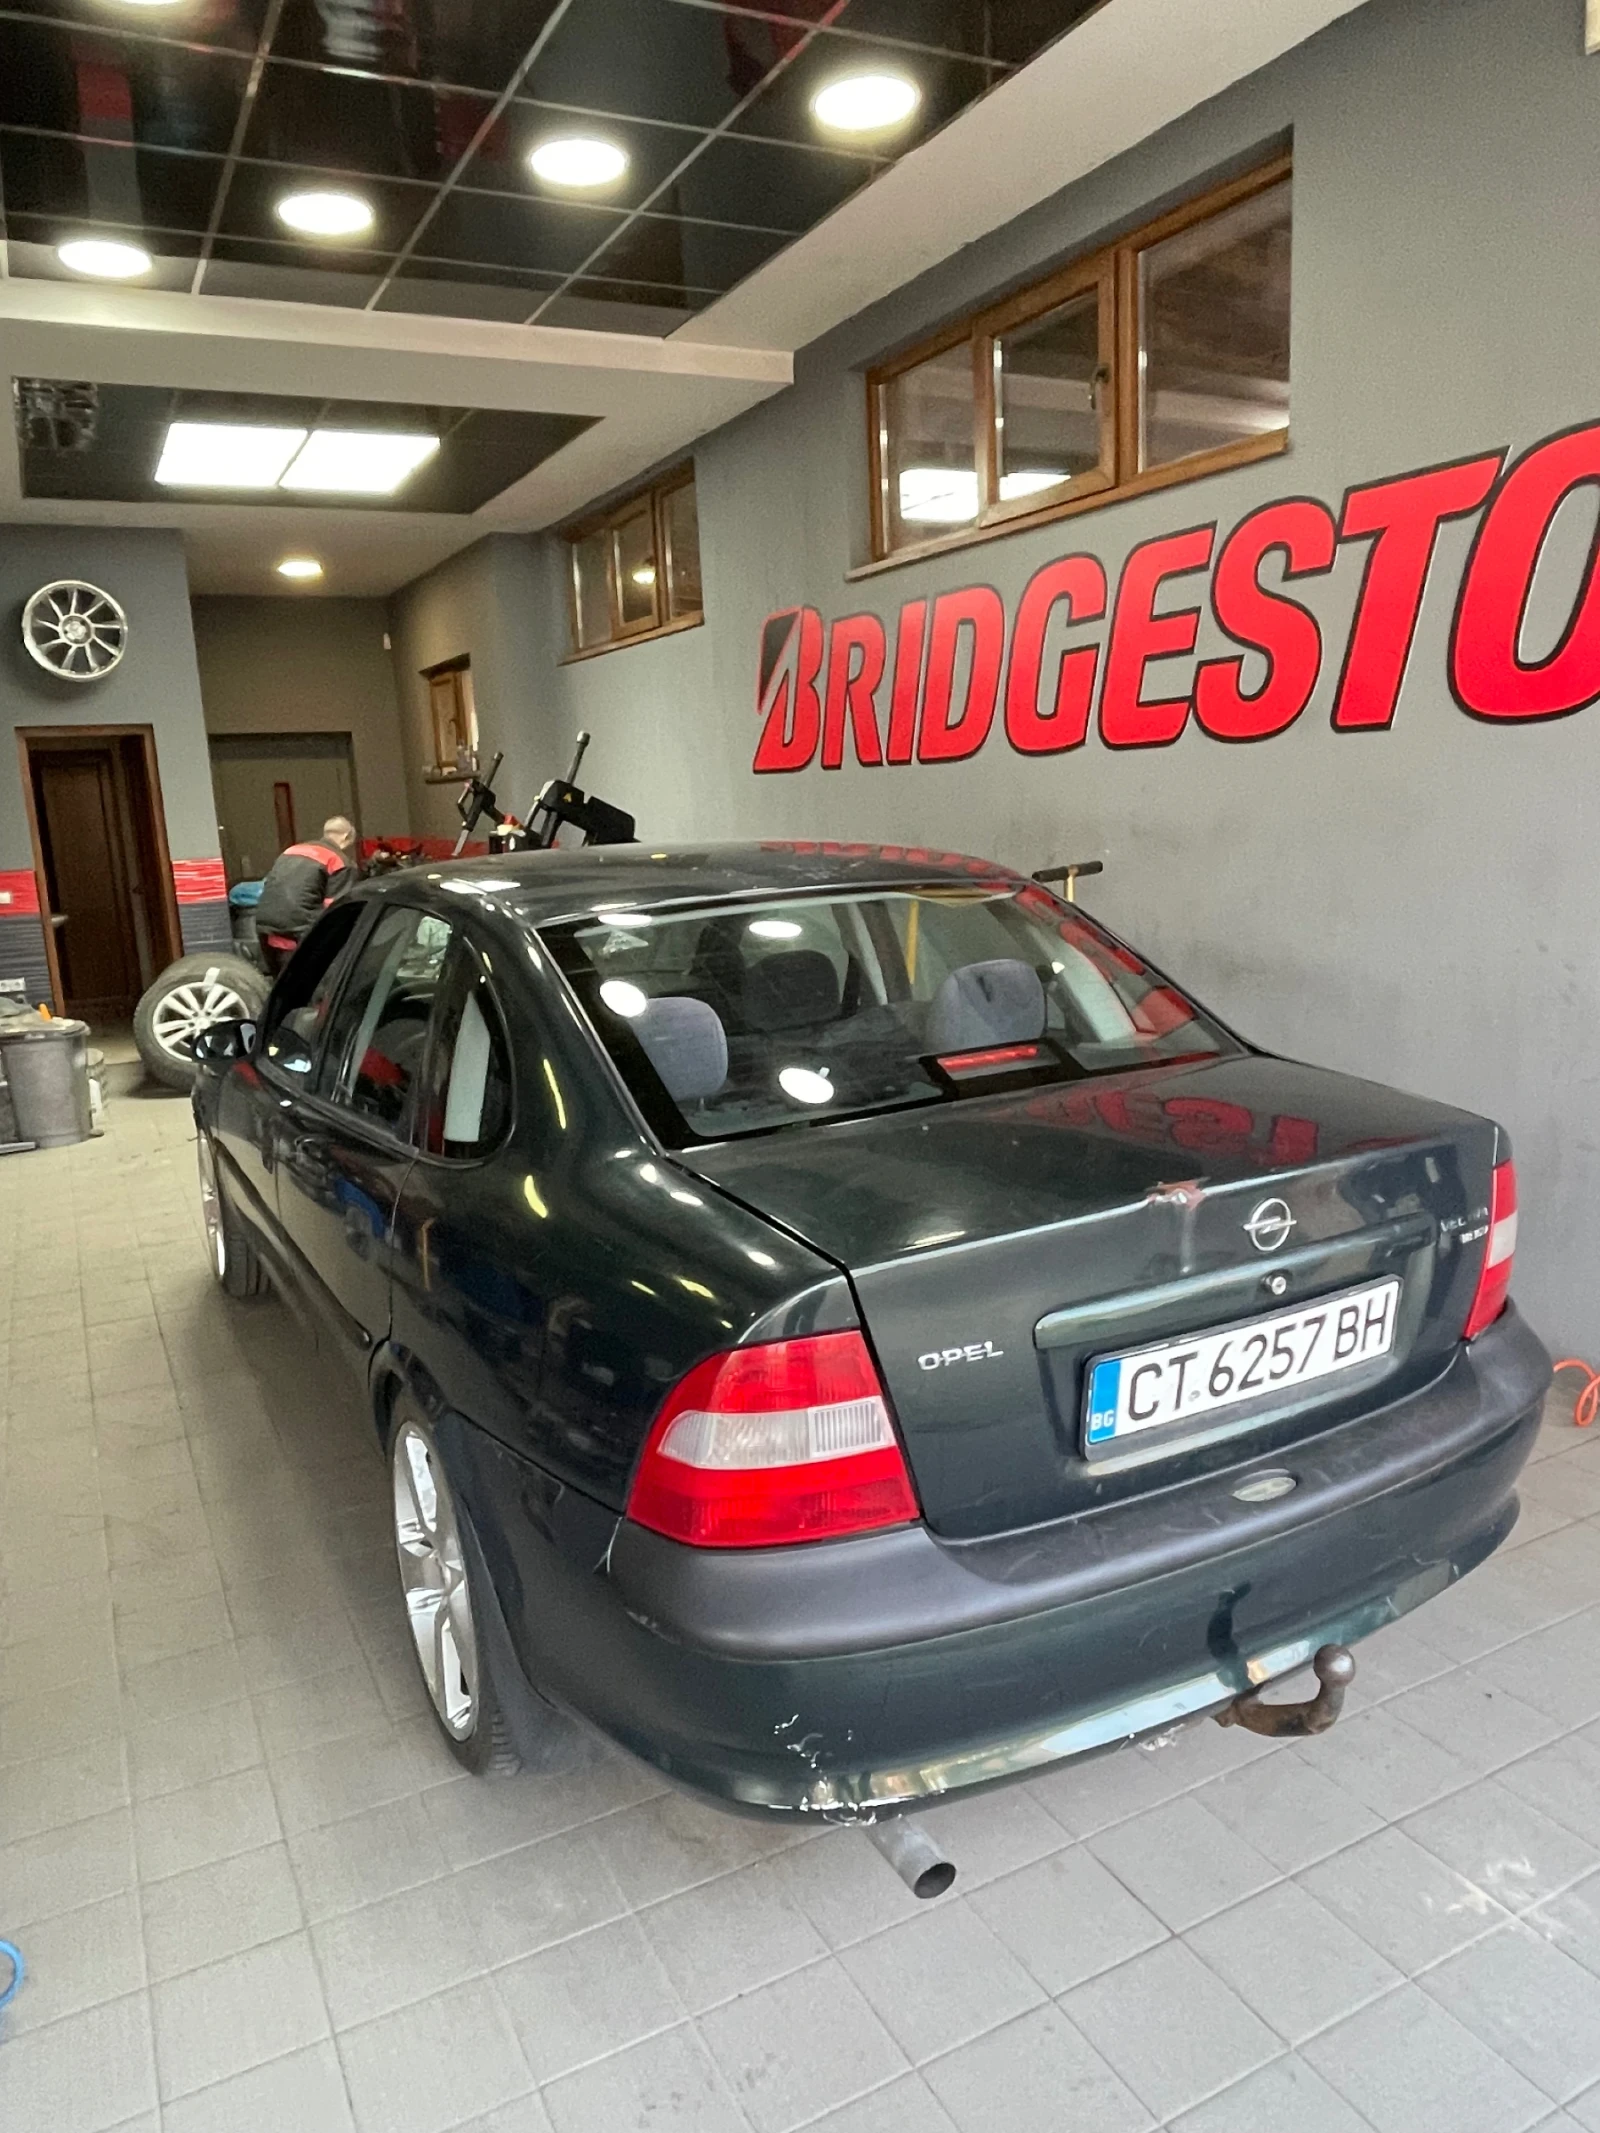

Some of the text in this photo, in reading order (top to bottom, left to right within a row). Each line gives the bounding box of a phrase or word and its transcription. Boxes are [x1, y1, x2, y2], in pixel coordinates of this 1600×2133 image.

[754, 418, 1600, 773] BRIDGESTO
[917, 1340, 1004, 1371] OPEL
[1207, 1316, 1326, 1397] 6257
[1333, 1291, 1389, 1360] BH
[1091, 1409, 1115, 1431] BG
